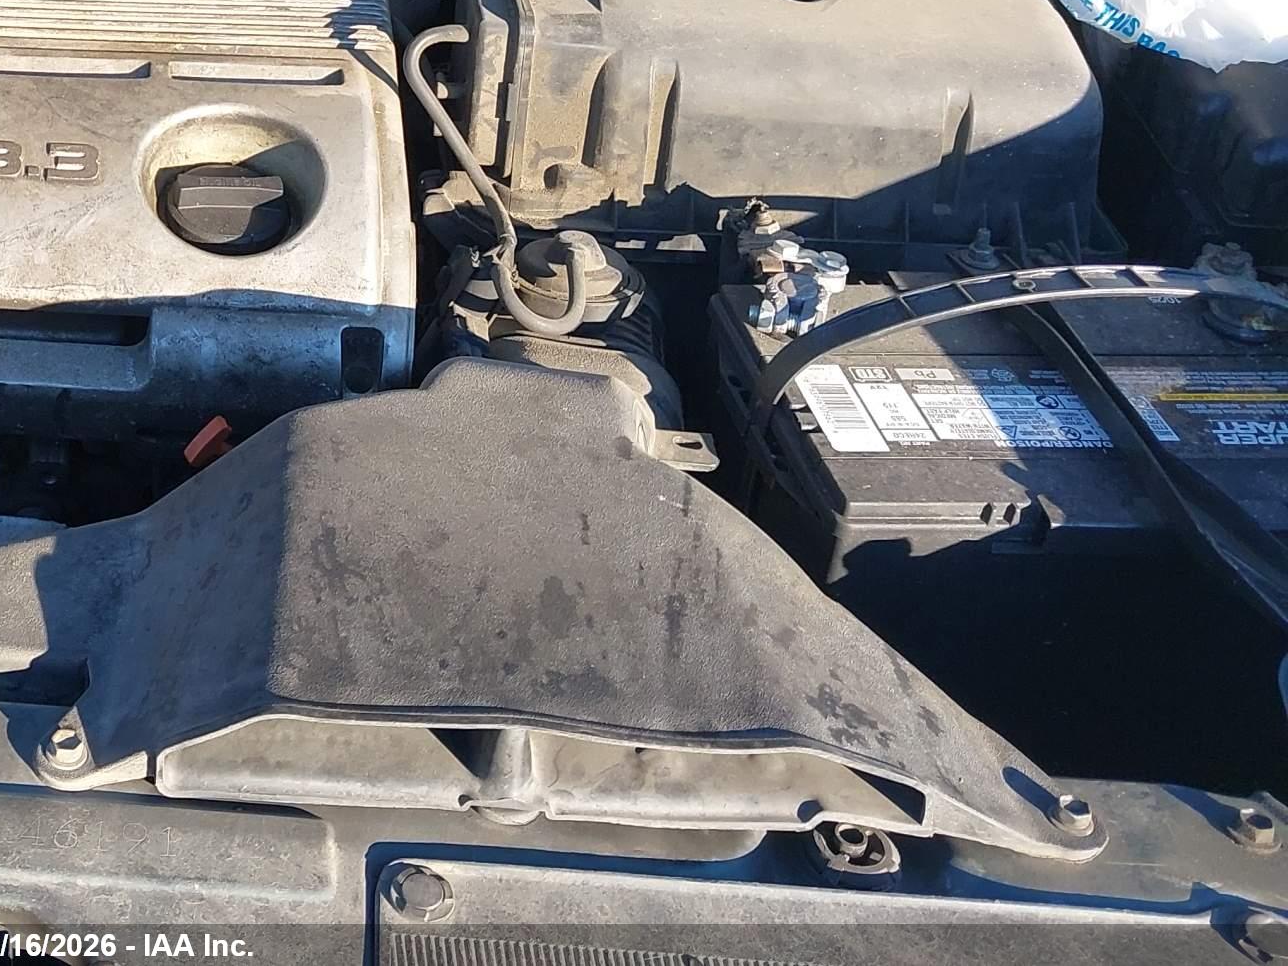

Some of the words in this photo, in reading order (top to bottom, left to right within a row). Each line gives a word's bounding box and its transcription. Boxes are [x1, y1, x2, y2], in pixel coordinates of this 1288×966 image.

[1094, 1, 1141, 38] THIS
[912, 370, 937, 380] Pb
[994, 440, 1114, 448] DANGER/POISON
